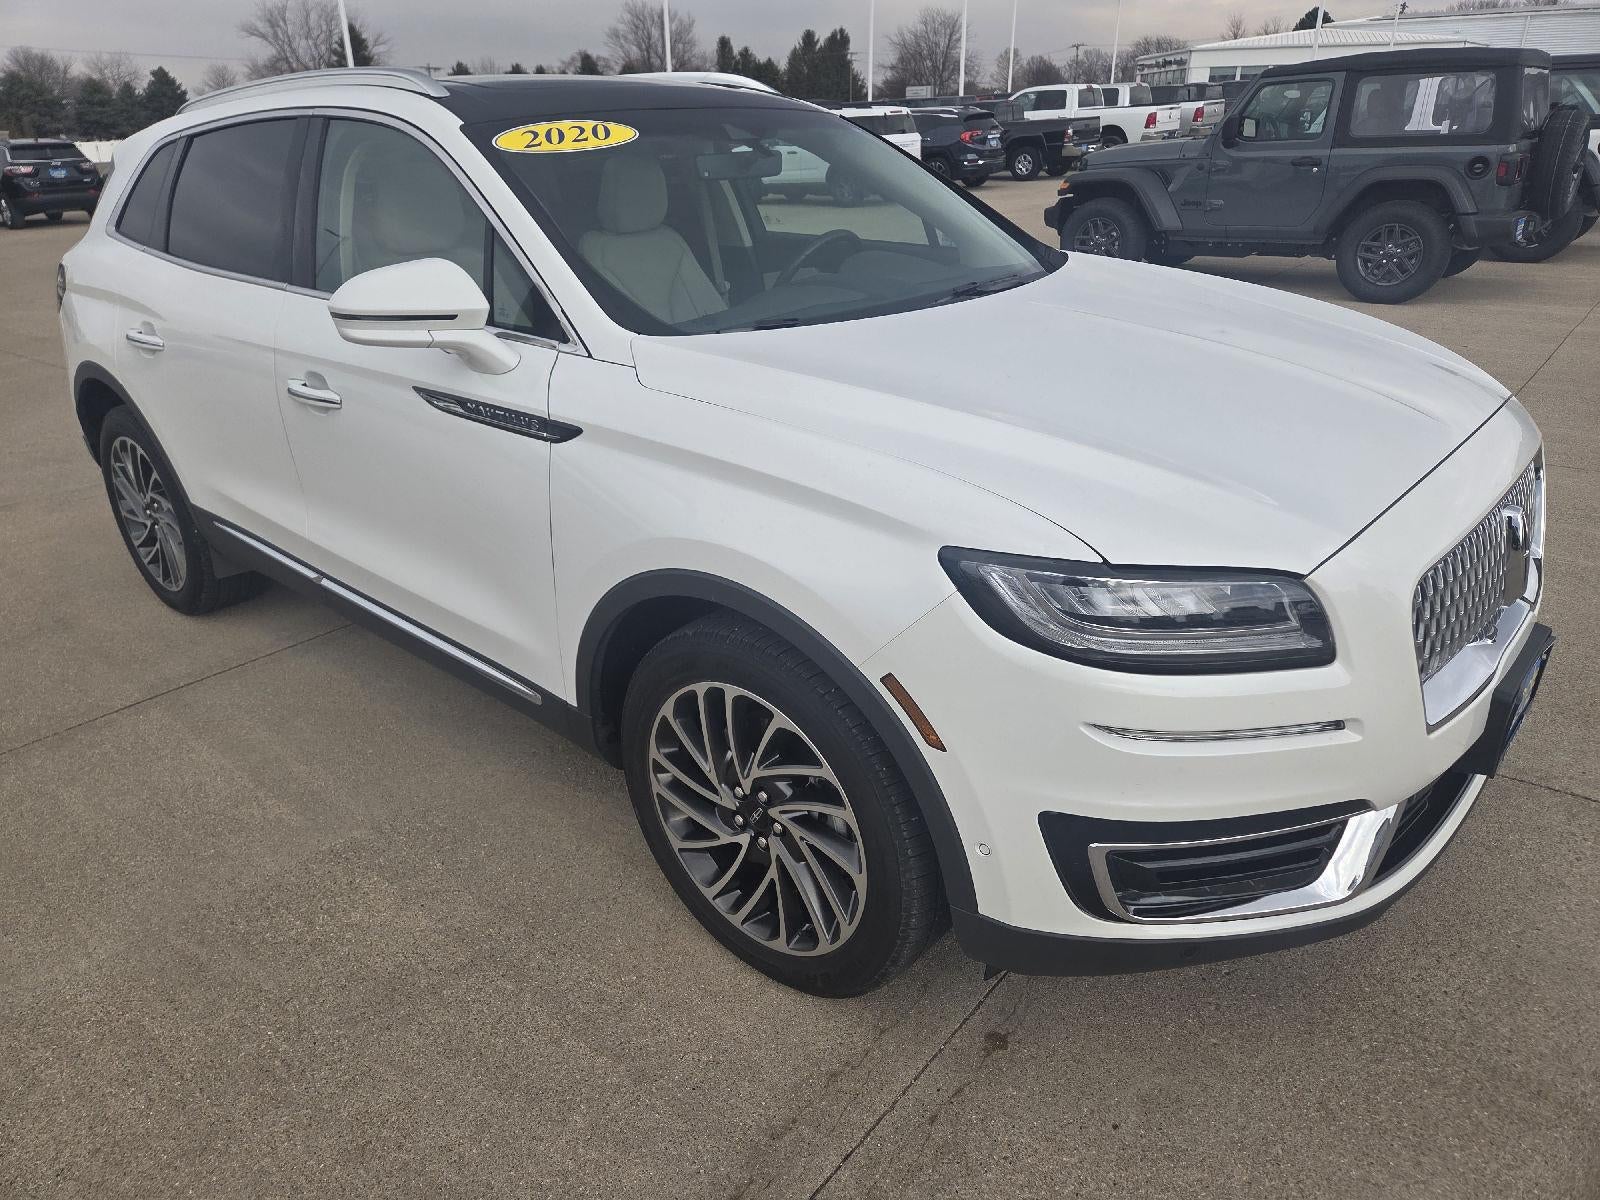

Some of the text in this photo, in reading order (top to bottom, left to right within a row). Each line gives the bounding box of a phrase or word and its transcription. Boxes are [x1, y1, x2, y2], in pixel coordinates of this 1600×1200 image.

[521, 123, 611, 149] 2020
[1180, 198, 1202, 208] Jeep
[466, 401, 540, 430] NAUTILUS
